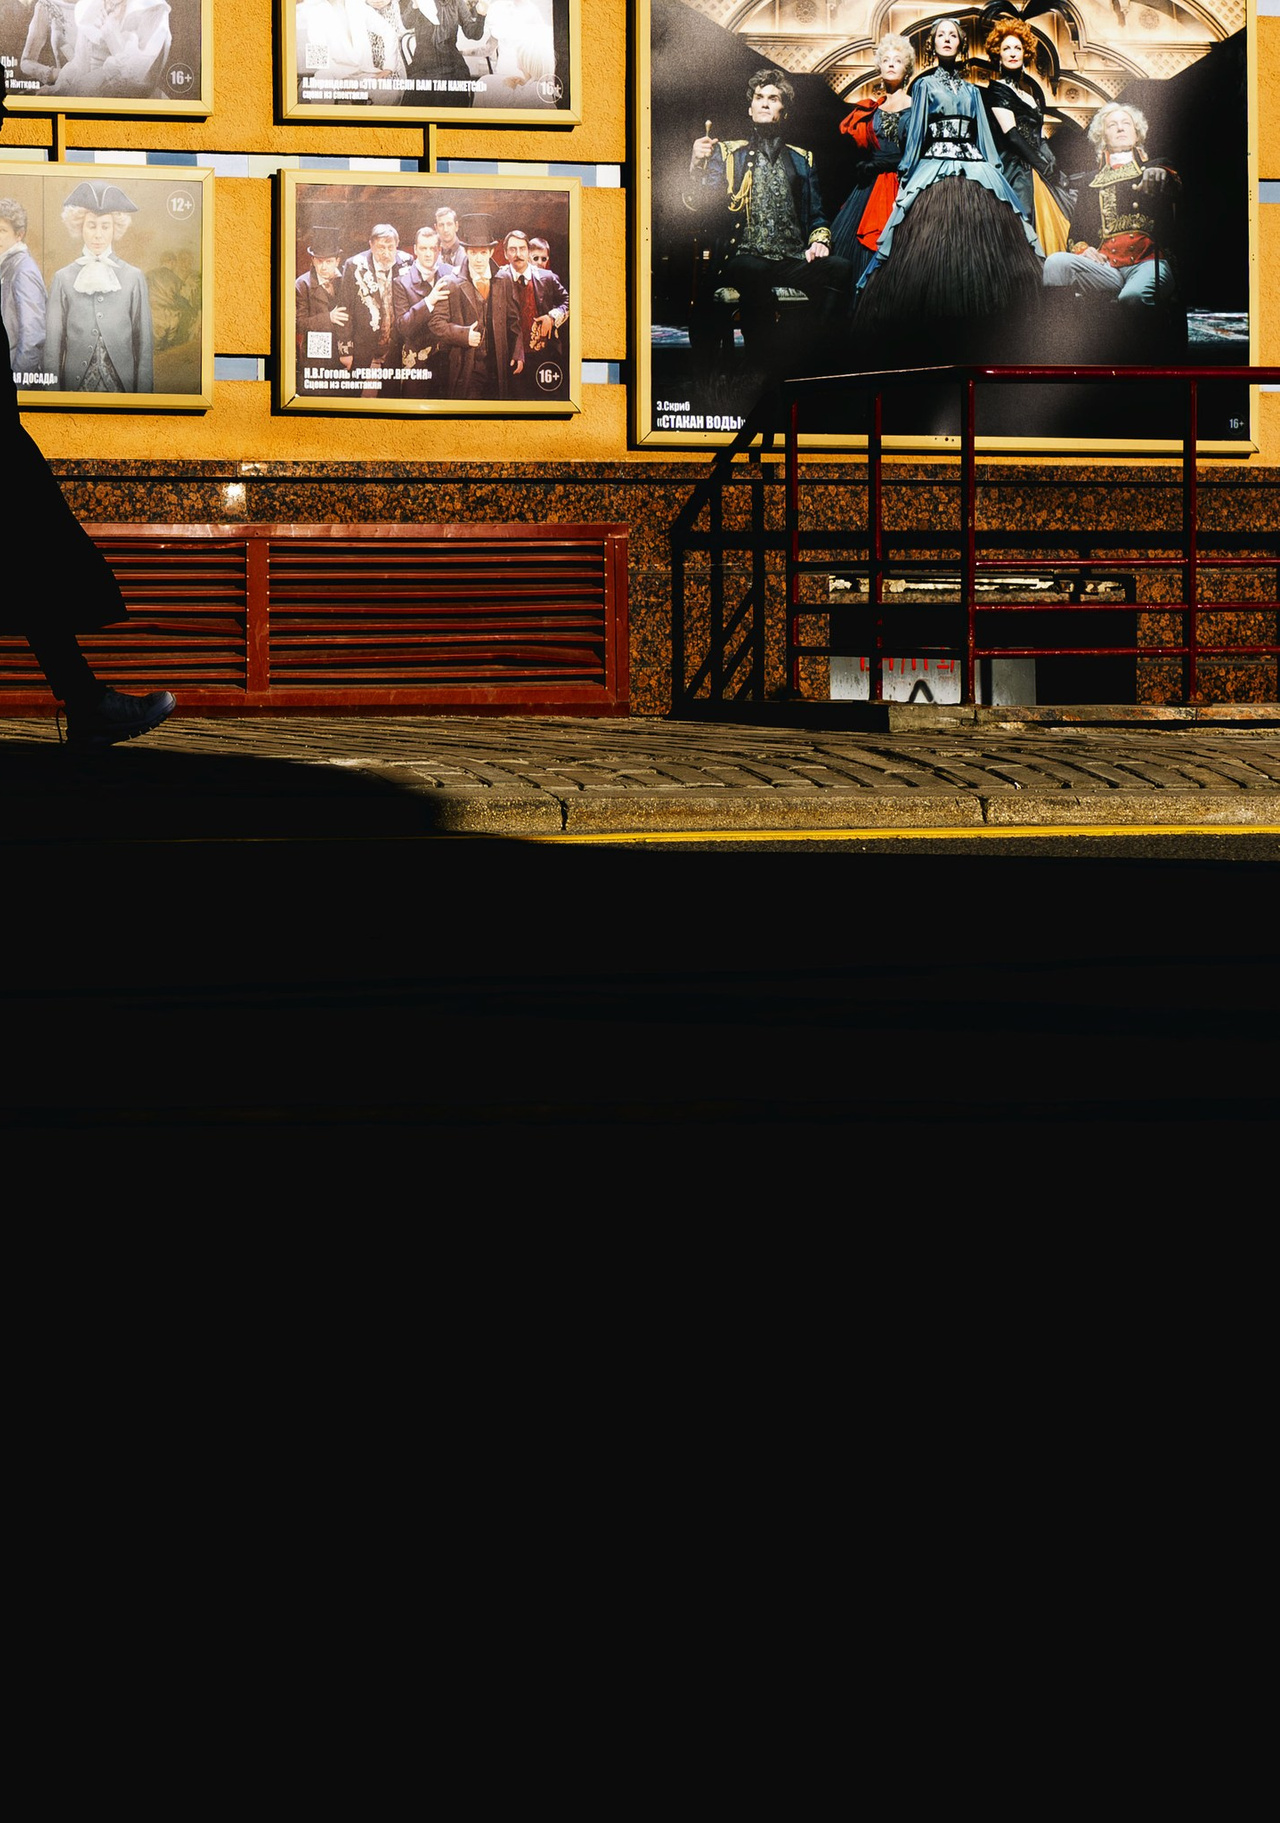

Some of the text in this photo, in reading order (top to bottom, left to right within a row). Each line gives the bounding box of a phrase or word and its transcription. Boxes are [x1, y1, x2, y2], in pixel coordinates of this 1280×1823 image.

[170, 70, 192, 85] 16+
[540, 81, 561, 95] 16+
[170, 197, 192, 212] 12+
[539, 369, 560, 383] 16+
[304, 379, 382, 390] Сцена из спектакля
[657, 415, 705, 429] «СТАКАН
[1229, 418, 1245, 429] 16+
